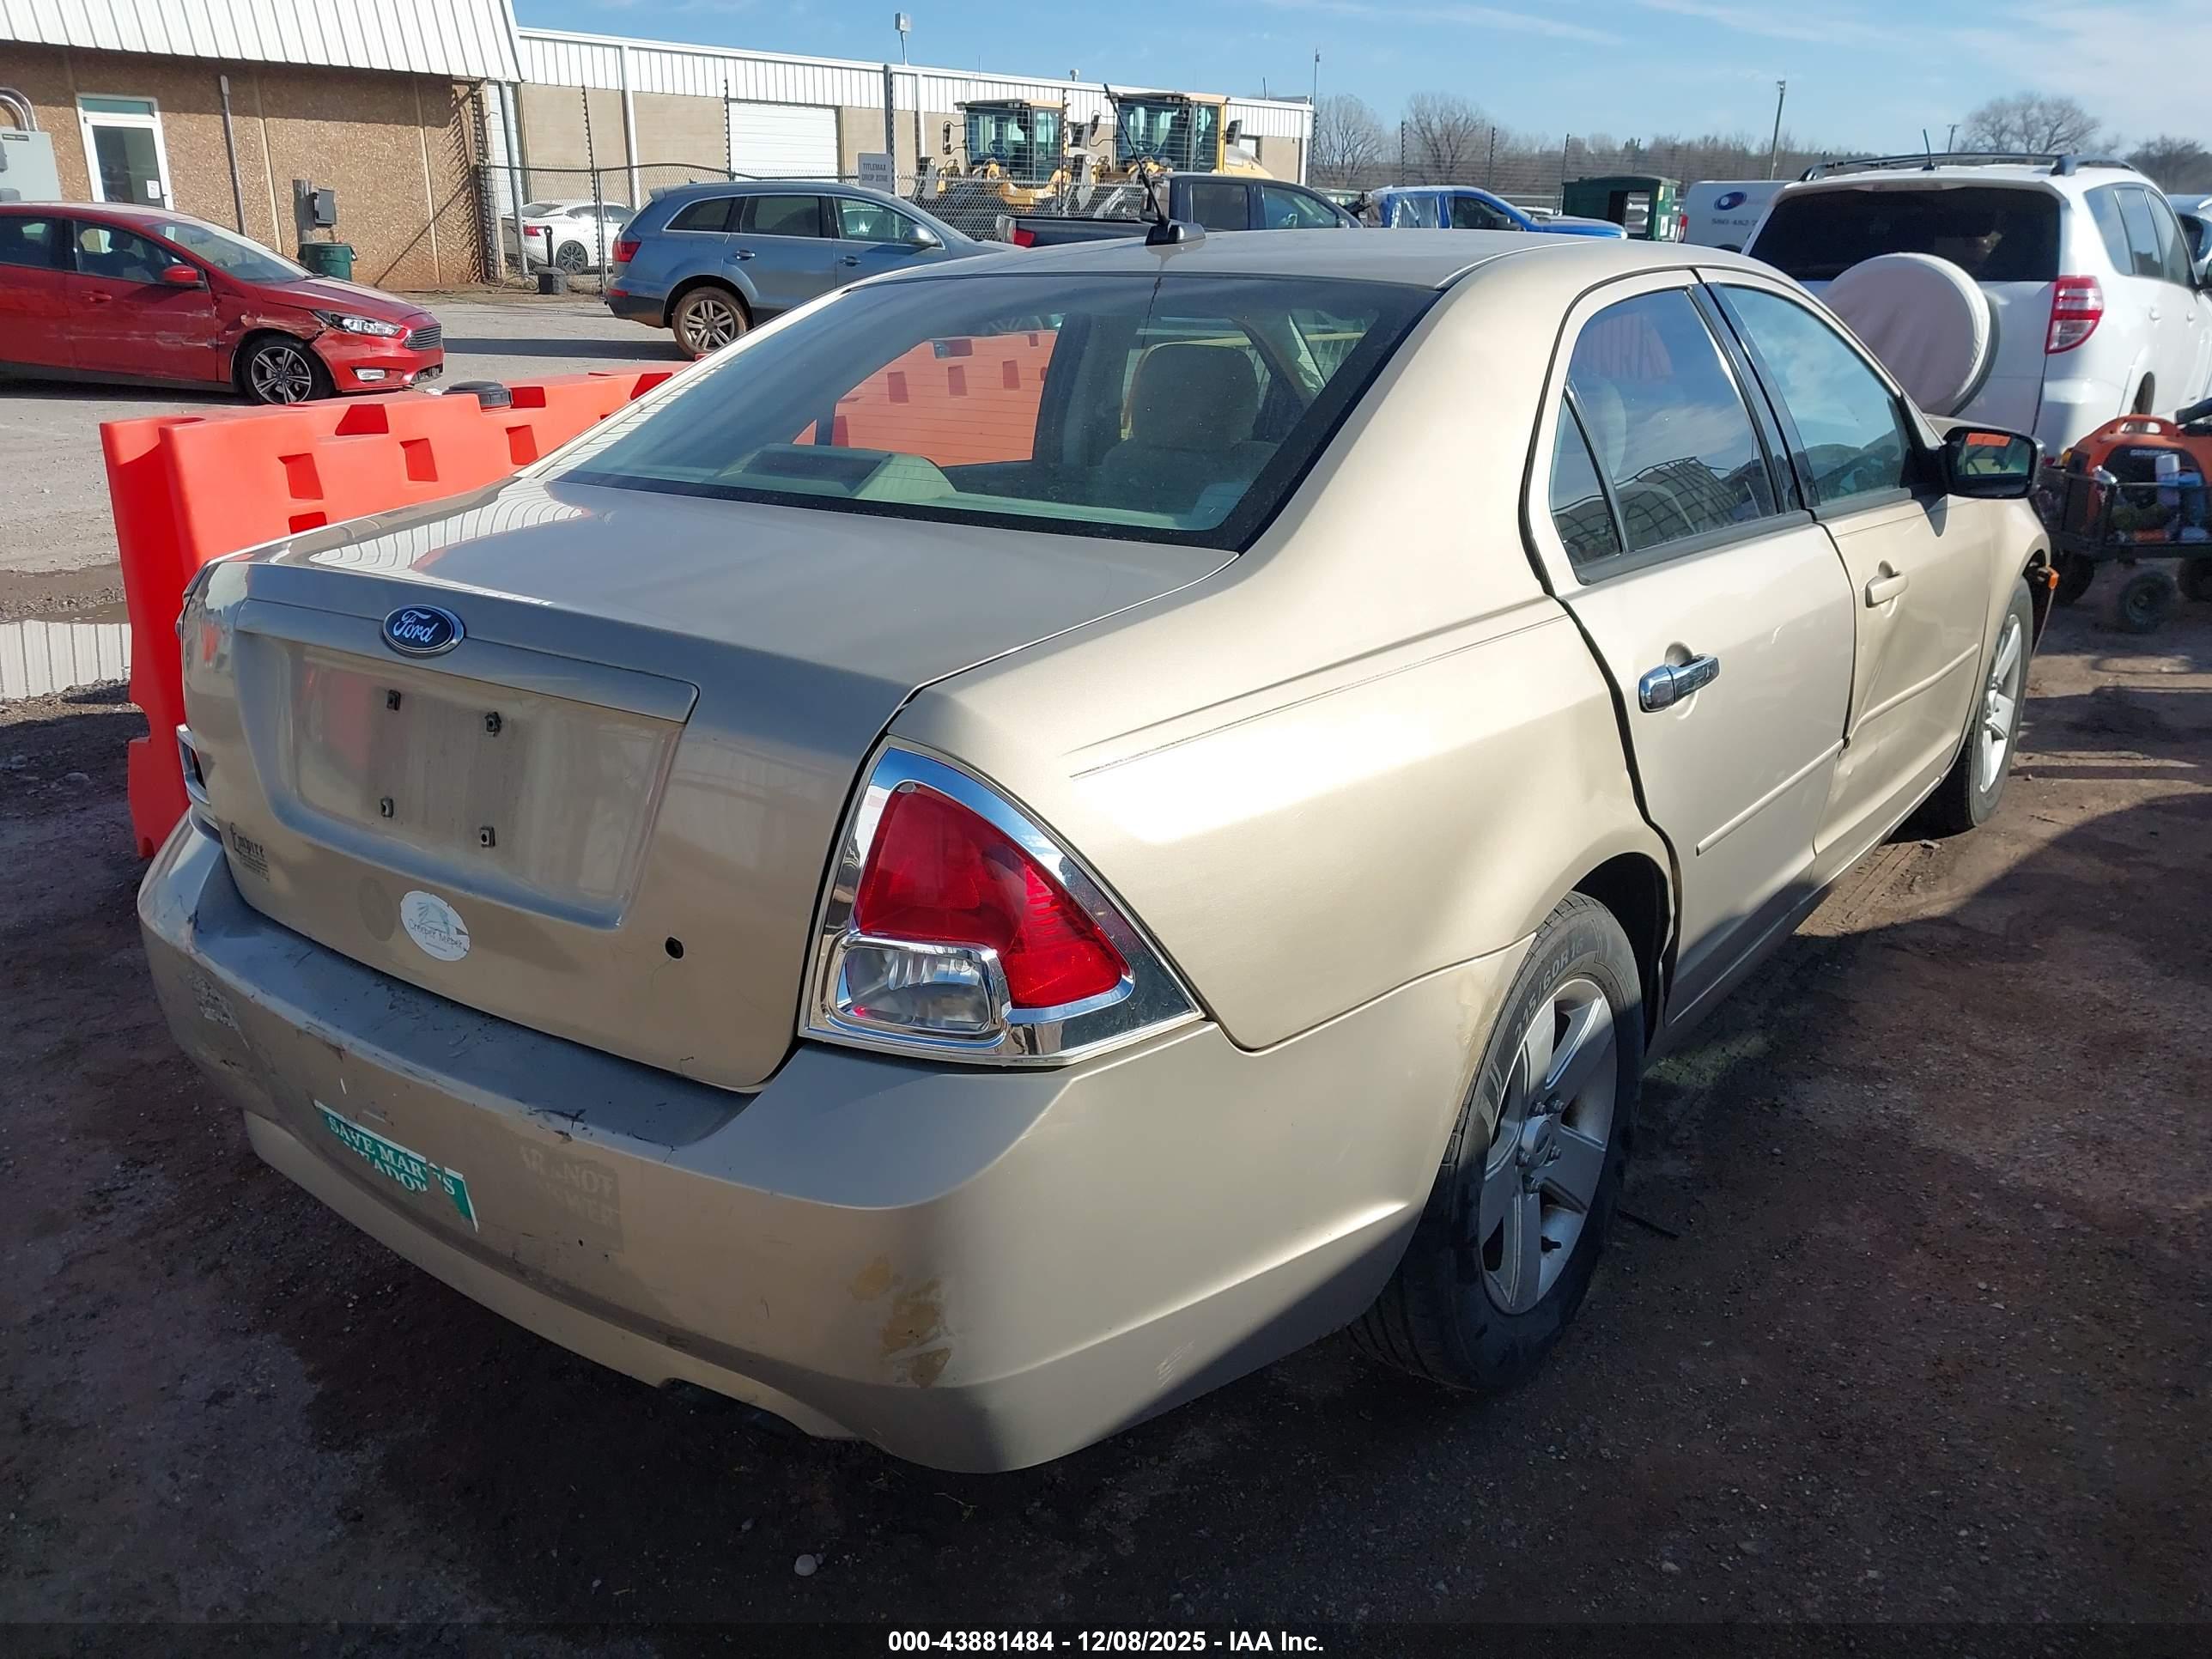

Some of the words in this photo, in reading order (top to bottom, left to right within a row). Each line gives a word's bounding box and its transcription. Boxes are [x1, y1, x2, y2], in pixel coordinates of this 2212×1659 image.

[862, 162, 886, 171] TITLEMAX
[392, 610, 440, 643] Ford
[328, 1116, 375, 1154] SAVE
